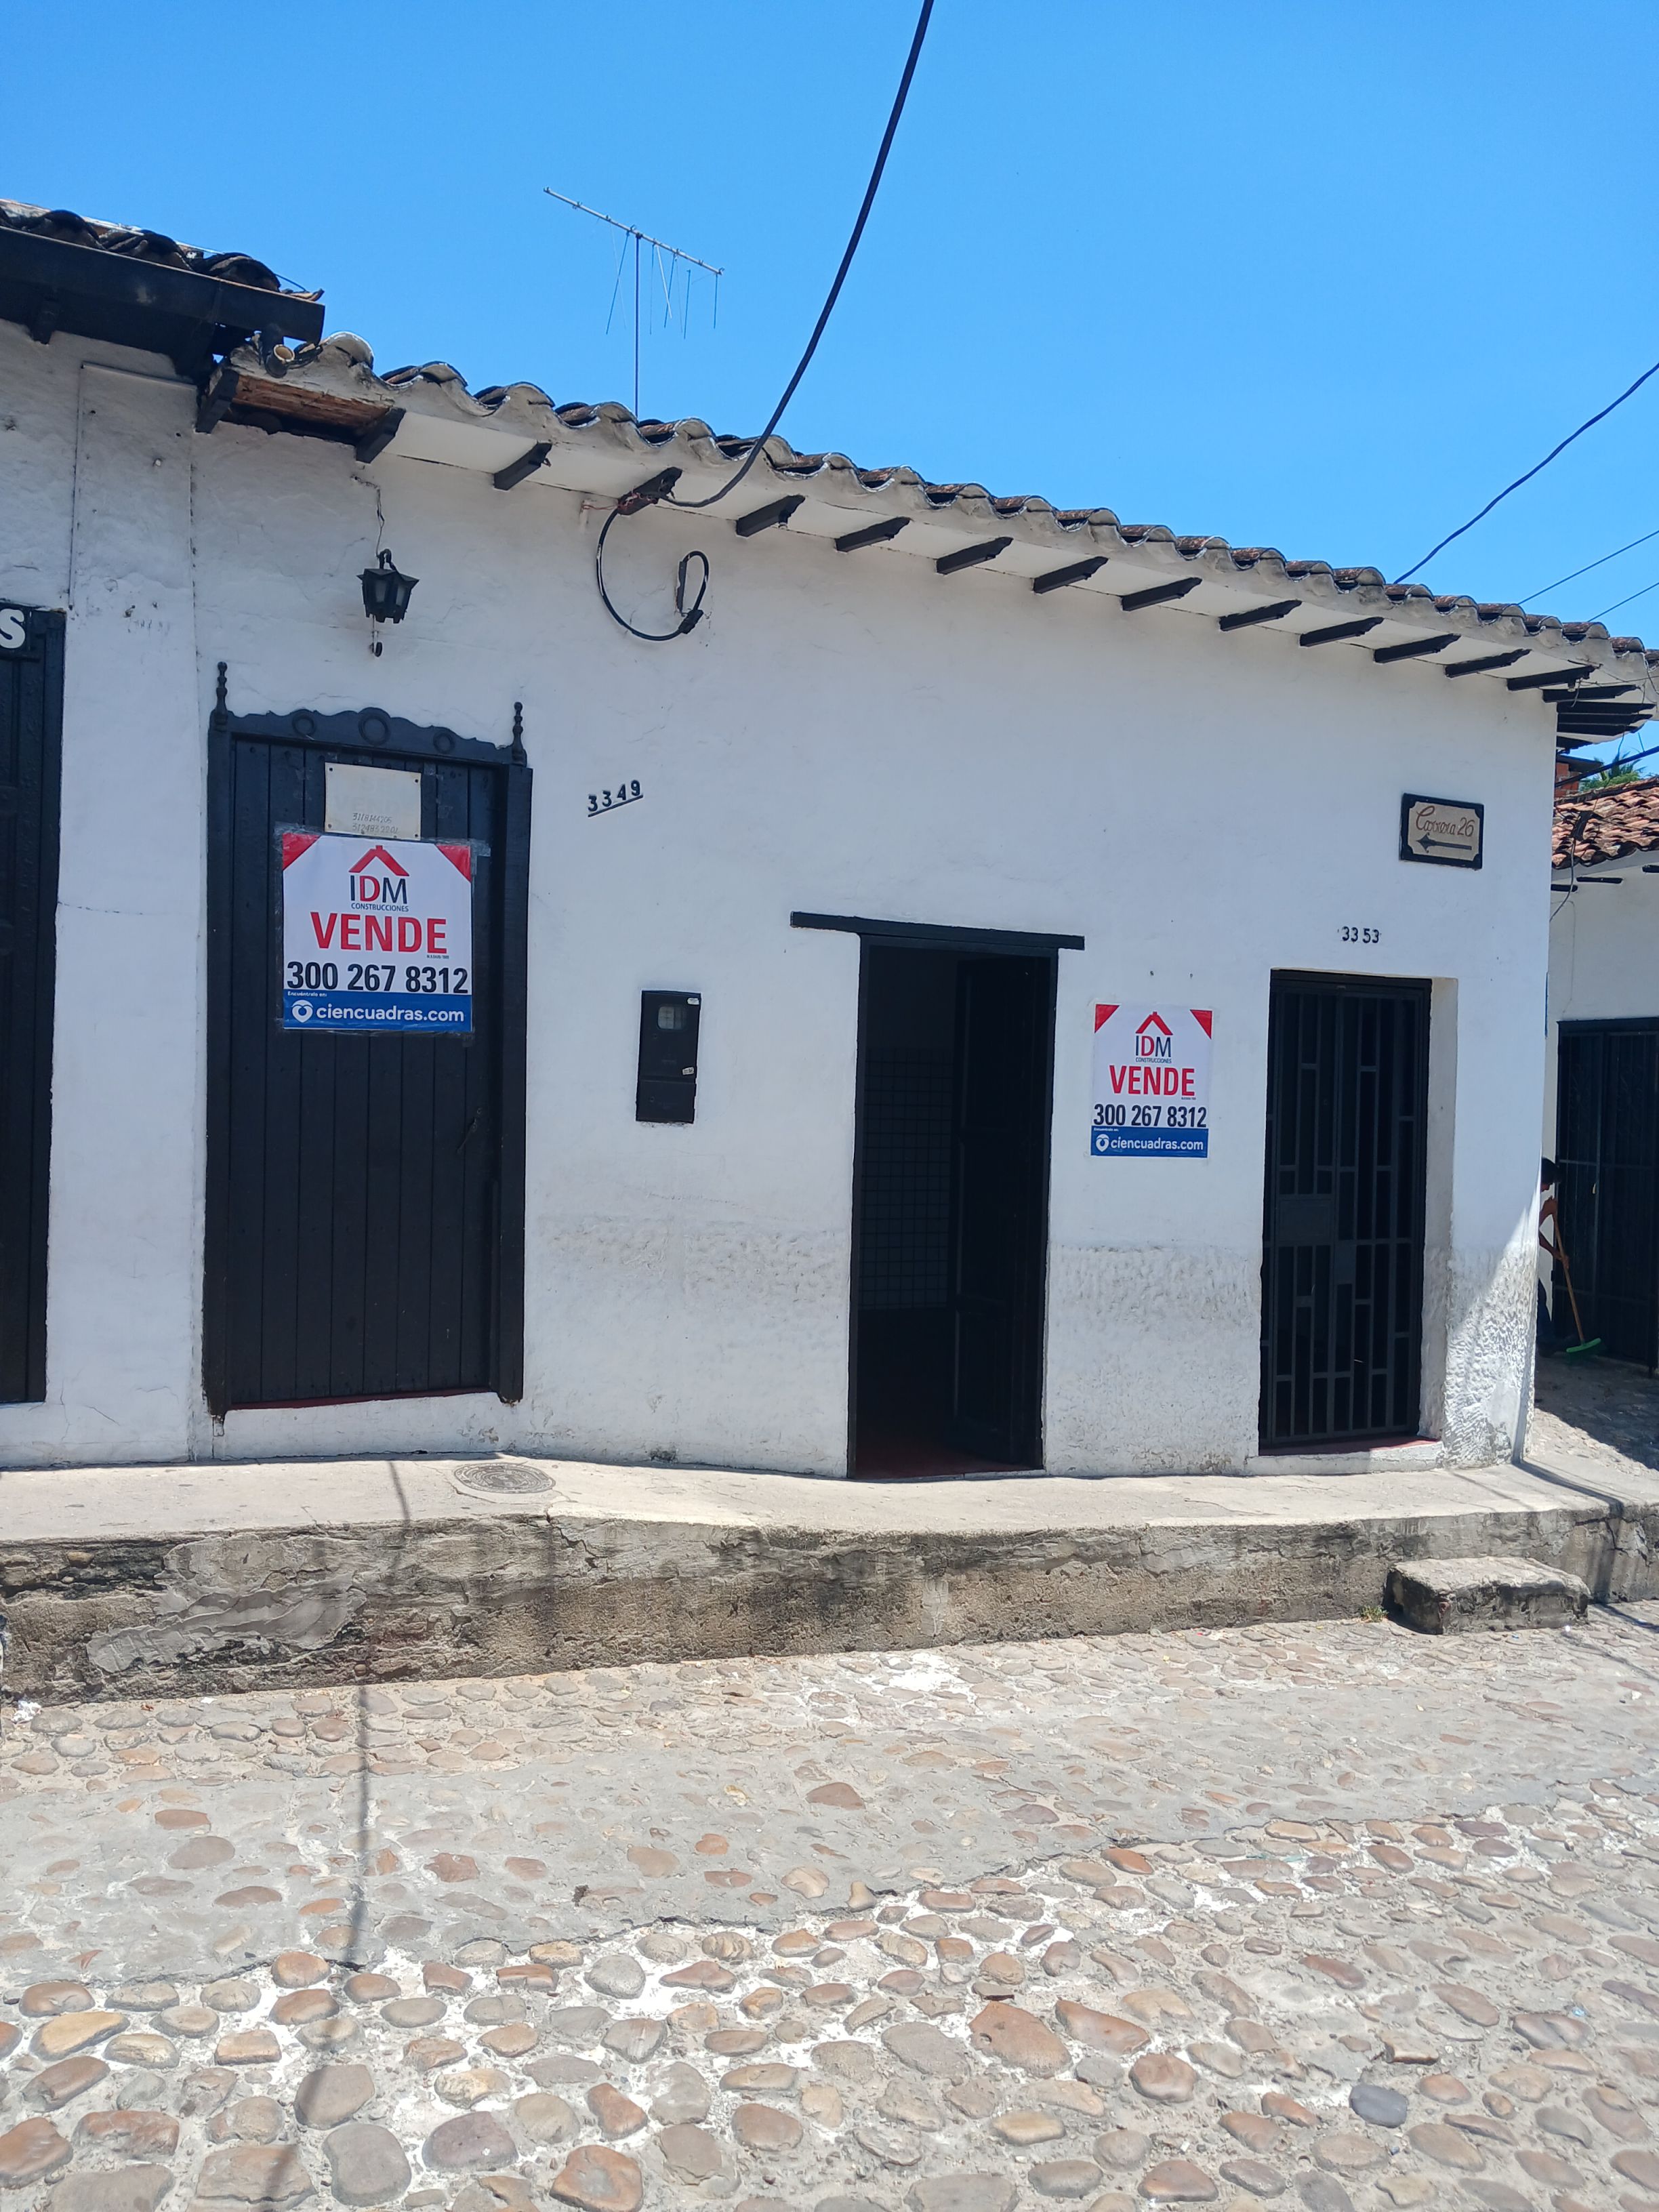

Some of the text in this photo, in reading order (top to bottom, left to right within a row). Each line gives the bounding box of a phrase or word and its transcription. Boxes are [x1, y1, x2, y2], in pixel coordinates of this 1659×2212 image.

[588, 779, 640, 812] 3349
[1416, 805, 1475, 837] Carrera 26
[350, 875, 408, 904] IDM
[351, 902, 409, 912] CONSTRUCCIONES
[310, 912, 447, 954] VENDE
[287, 961, 468, 994] 300 267 8312
[316, 1003, 464, 1022] ciencuadras.com
[1135, 1035, 1172, 1057] IDM
[1109, 1065, 1195, 1097] VENDE
[1093, 1103, 1207, 1128] 300 267 8312
[1111, 1136, 1204, 1150] ciencuadras.com
